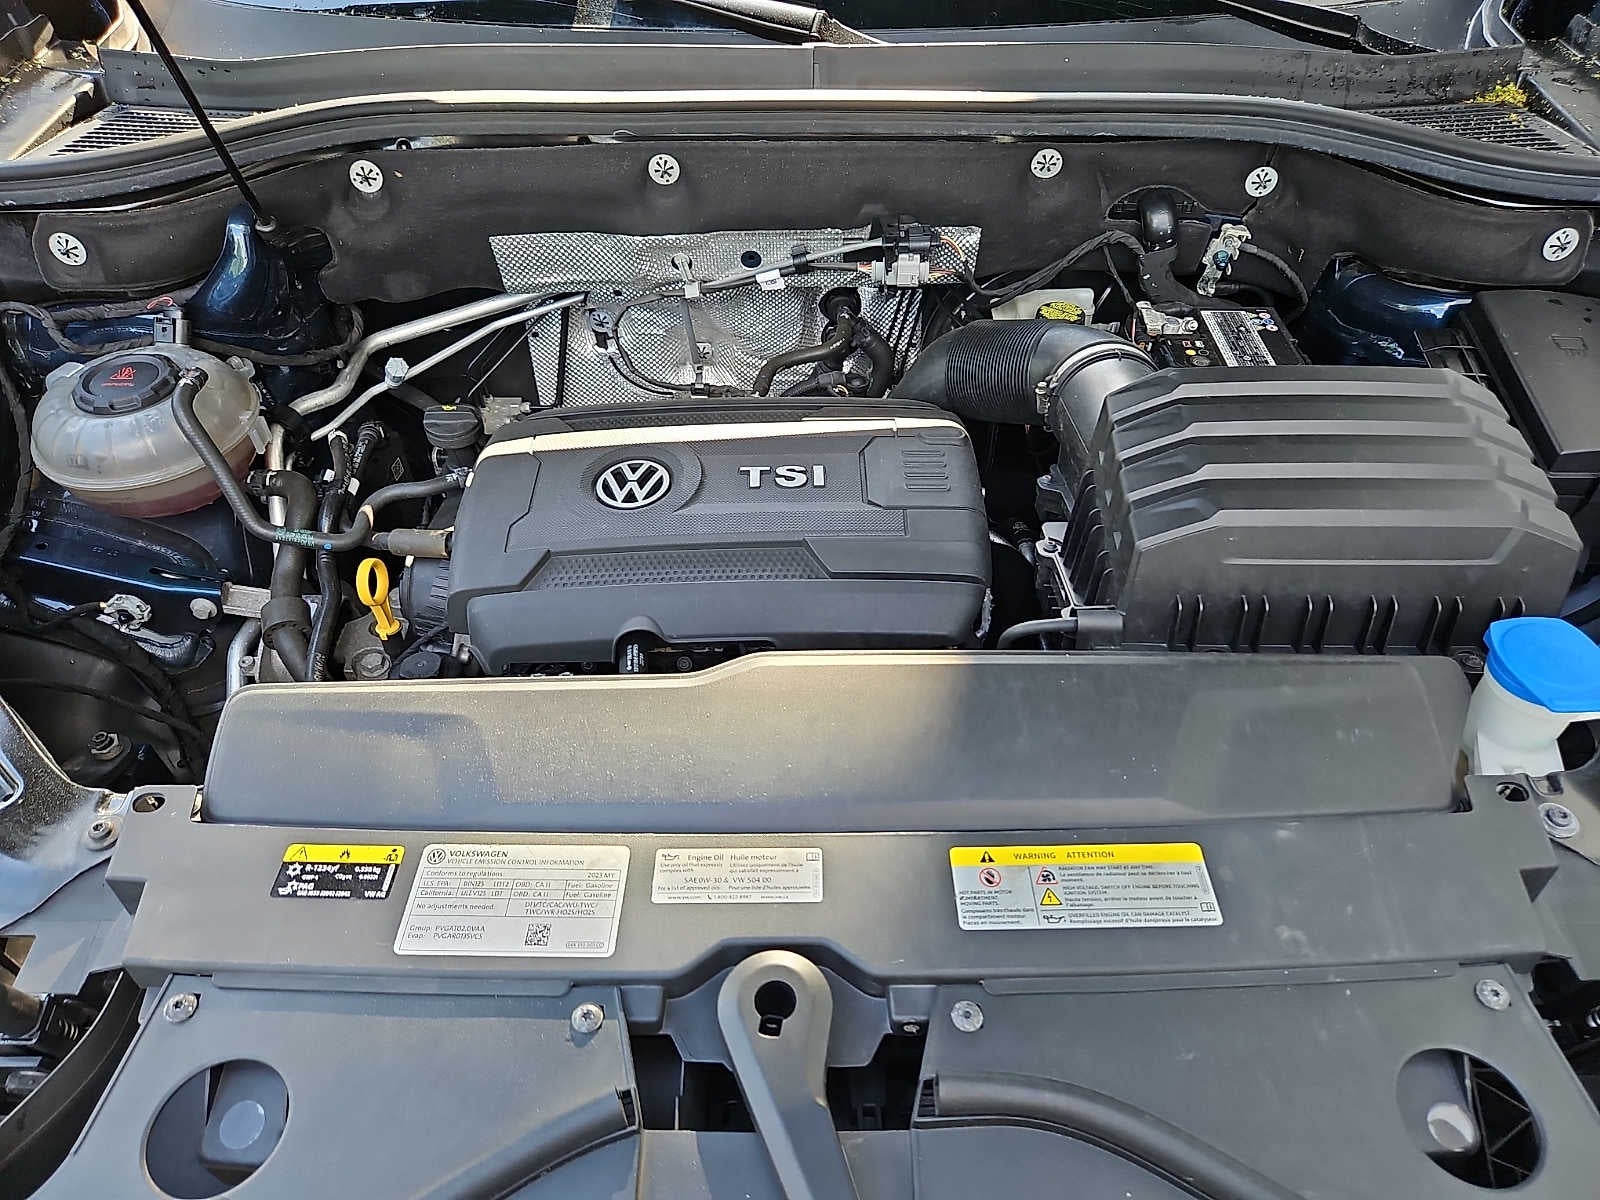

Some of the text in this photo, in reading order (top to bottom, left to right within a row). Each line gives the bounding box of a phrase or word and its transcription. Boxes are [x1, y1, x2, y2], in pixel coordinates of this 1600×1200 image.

[740, 465, 825, 488] TSI
[449, 850, 508, 858] VOLKSWAGEN
[688, 854, 712, 862] Engine
[1013, 851, 1115, 860] WARNING ATTENTION
[427, 903, 468, 911] adjustments
